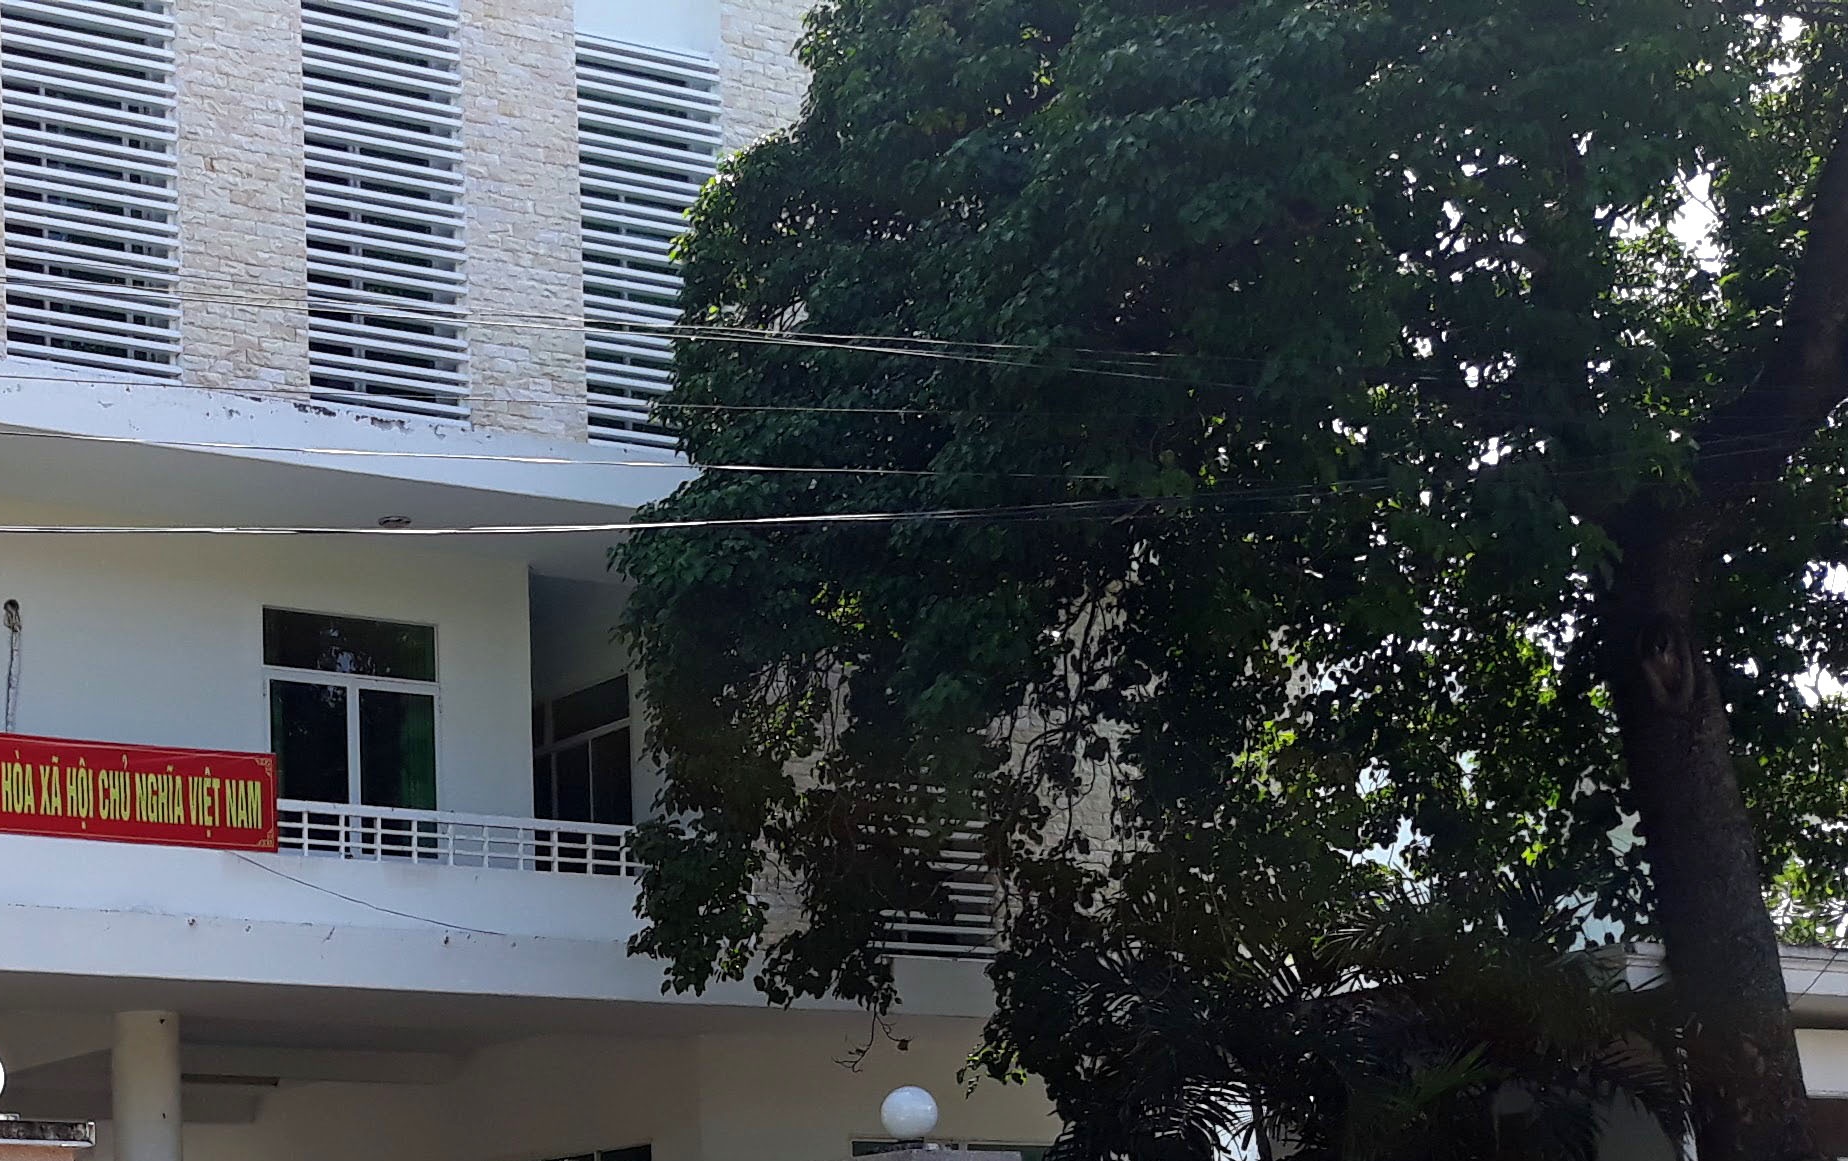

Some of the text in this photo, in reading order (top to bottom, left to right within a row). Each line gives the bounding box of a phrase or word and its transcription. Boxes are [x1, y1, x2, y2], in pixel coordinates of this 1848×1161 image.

[1, 750, 36, 815] HÒA
[39, 756, 63, 817] XÃ
[66, 757, 94, 830] HỘI
[98, 754, 131, 821] CHỦ
[135, 764, 185, 825] NGHĨA
[188, 766, 221, 838] VIỆT
[224, 778, 263, 830] NAM
